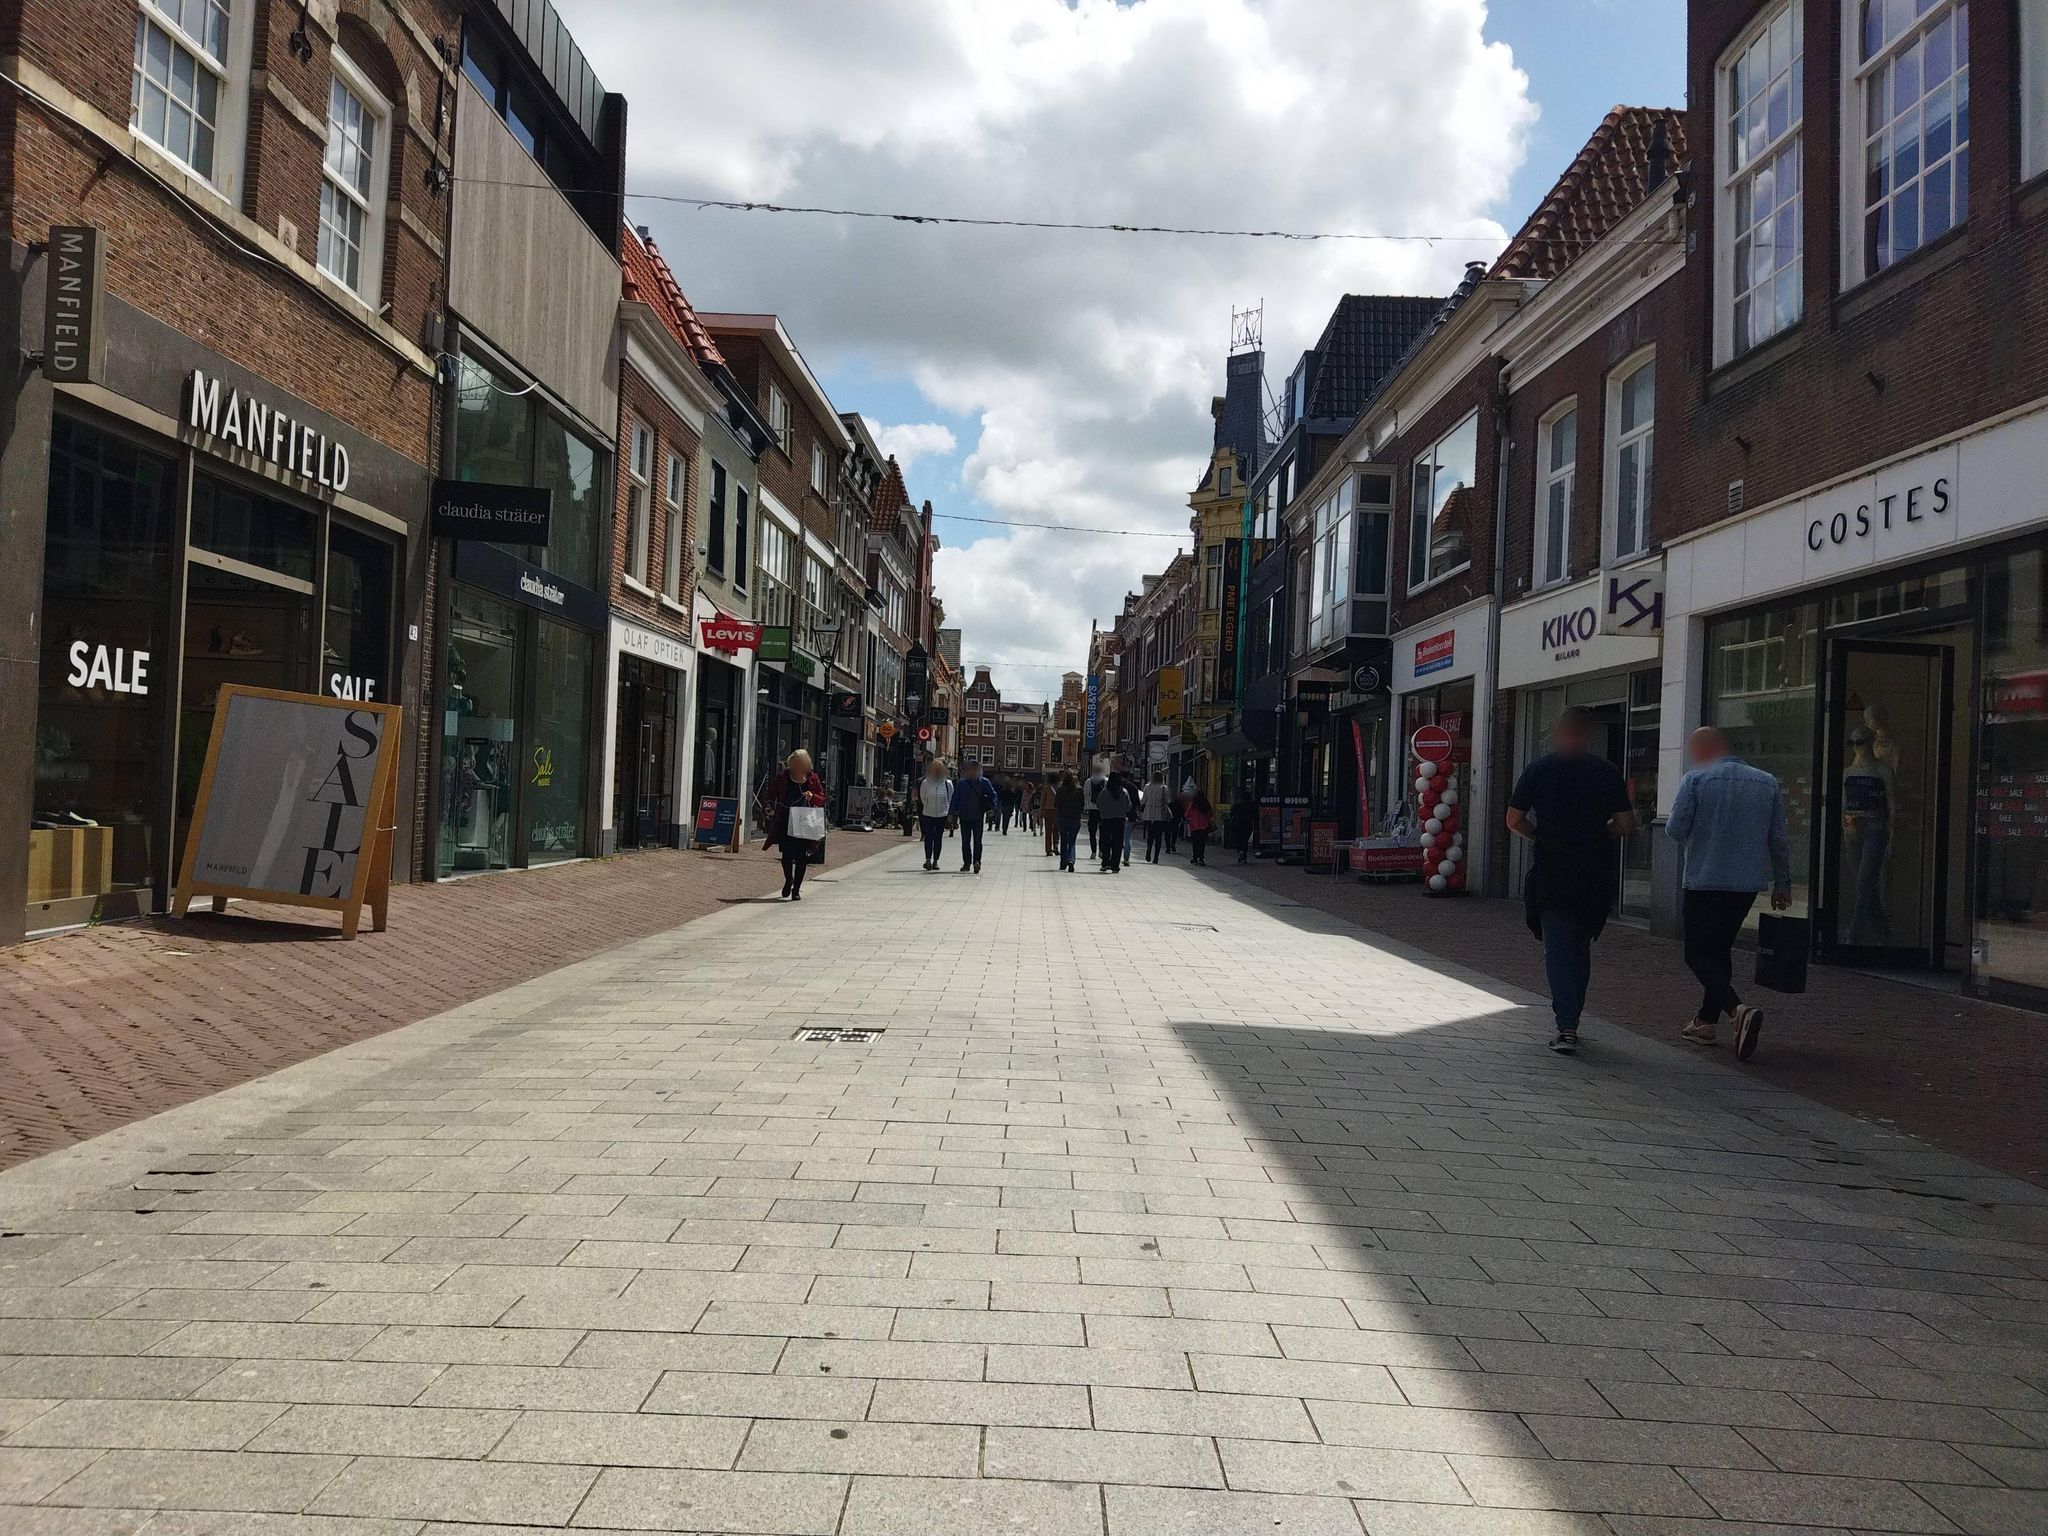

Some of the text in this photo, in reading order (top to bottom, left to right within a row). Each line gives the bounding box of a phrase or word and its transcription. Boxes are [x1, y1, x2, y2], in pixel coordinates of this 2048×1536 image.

[53, 233, 83, 372] MANFIELD
[190, 369, 350, 493] MANFIELD
[438, 501, 545, 524] claudia sträter
[1808, 478, 1949, 551] COSTES
[1224, 585, 1236, 652] PME LEGEND
[1542, 606, 1597, 650] KIKO
[623, 627, 685, 664] OLAF OPTIEK
[1555, 649, 1580, 661] MILANO
[67, 640, 150, 695] SALE
[331, 673, 376, 702] SALE
[2000, 775, 2014, 783] SALE
[2009, 789, 2023, 797] SALE
[299, 709, 379, 899] SALE
[1990, 802, 2003, 810] SALE
[2008, 828, 2022, 836] SALE
[1313, 846, 1334, 858] SALE
